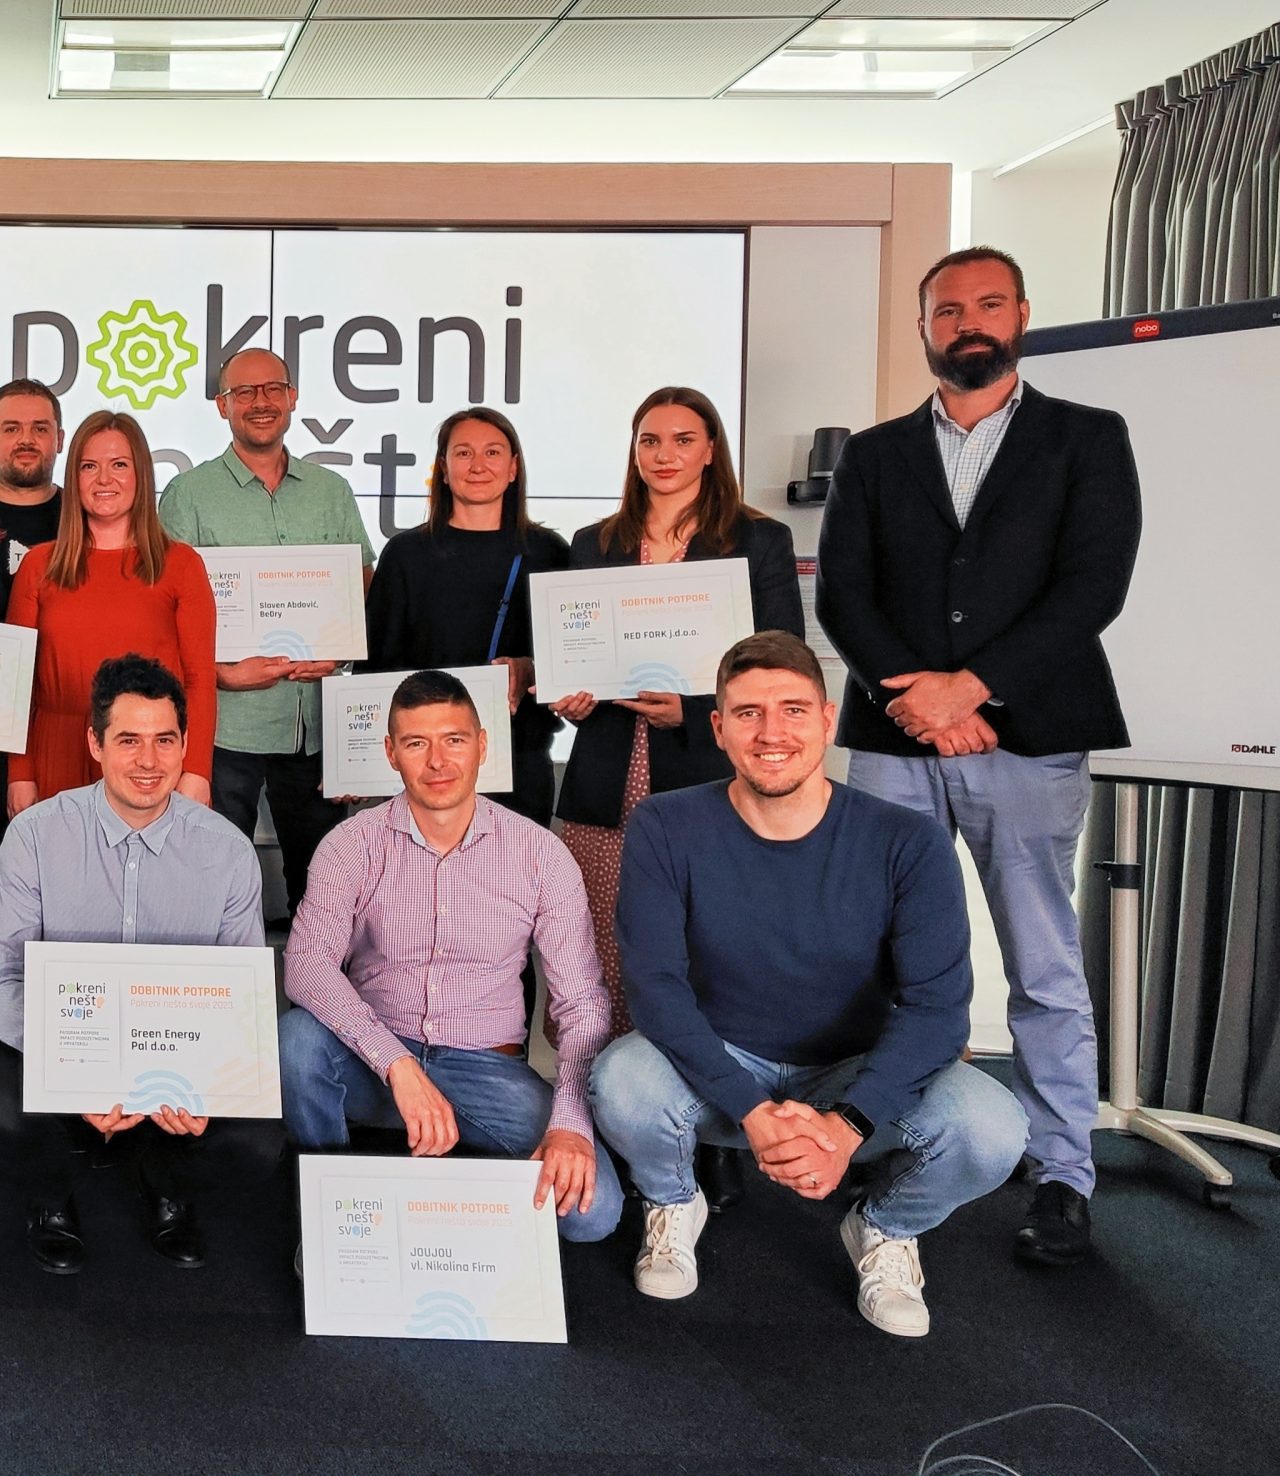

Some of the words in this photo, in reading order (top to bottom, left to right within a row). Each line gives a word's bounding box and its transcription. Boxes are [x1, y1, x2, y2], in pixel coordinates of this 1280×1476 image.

[1135, 324, 1158, 332] nobo
[258, 571, 294, 580] DOBITNIK
[297, 570, 331, 578] POTPORE
[214, 588, 232, 598] voje
[622, 595, 665, 607] DOBITNIK
[668, 594, 711, 603] POTPORE
[624, 632, 641, 640] RED
[644, 630, 667, 639] FORK
[1242, 745, 1276, 754] DAHLE
[130, 985, 181, 996] DOBITNIK
[183, 986, 232, 997] POTPORE
[131, 1028, 162, 1039] Green
[165, 1029, 201, 1042] Energy
[151, 1042, 178, 1052] d.o.o.
[408, 1202, 458, 1213] DOBITNIK
[461, 1203, 510, 1214] POTPORE
[410, 1247, 452, 1258] JOUJOU
[411, 1261, 423, 1271] vl.
[426, 1261, 469, 1272] Nikolina
[473, 1261, 496, 1273] Firm
